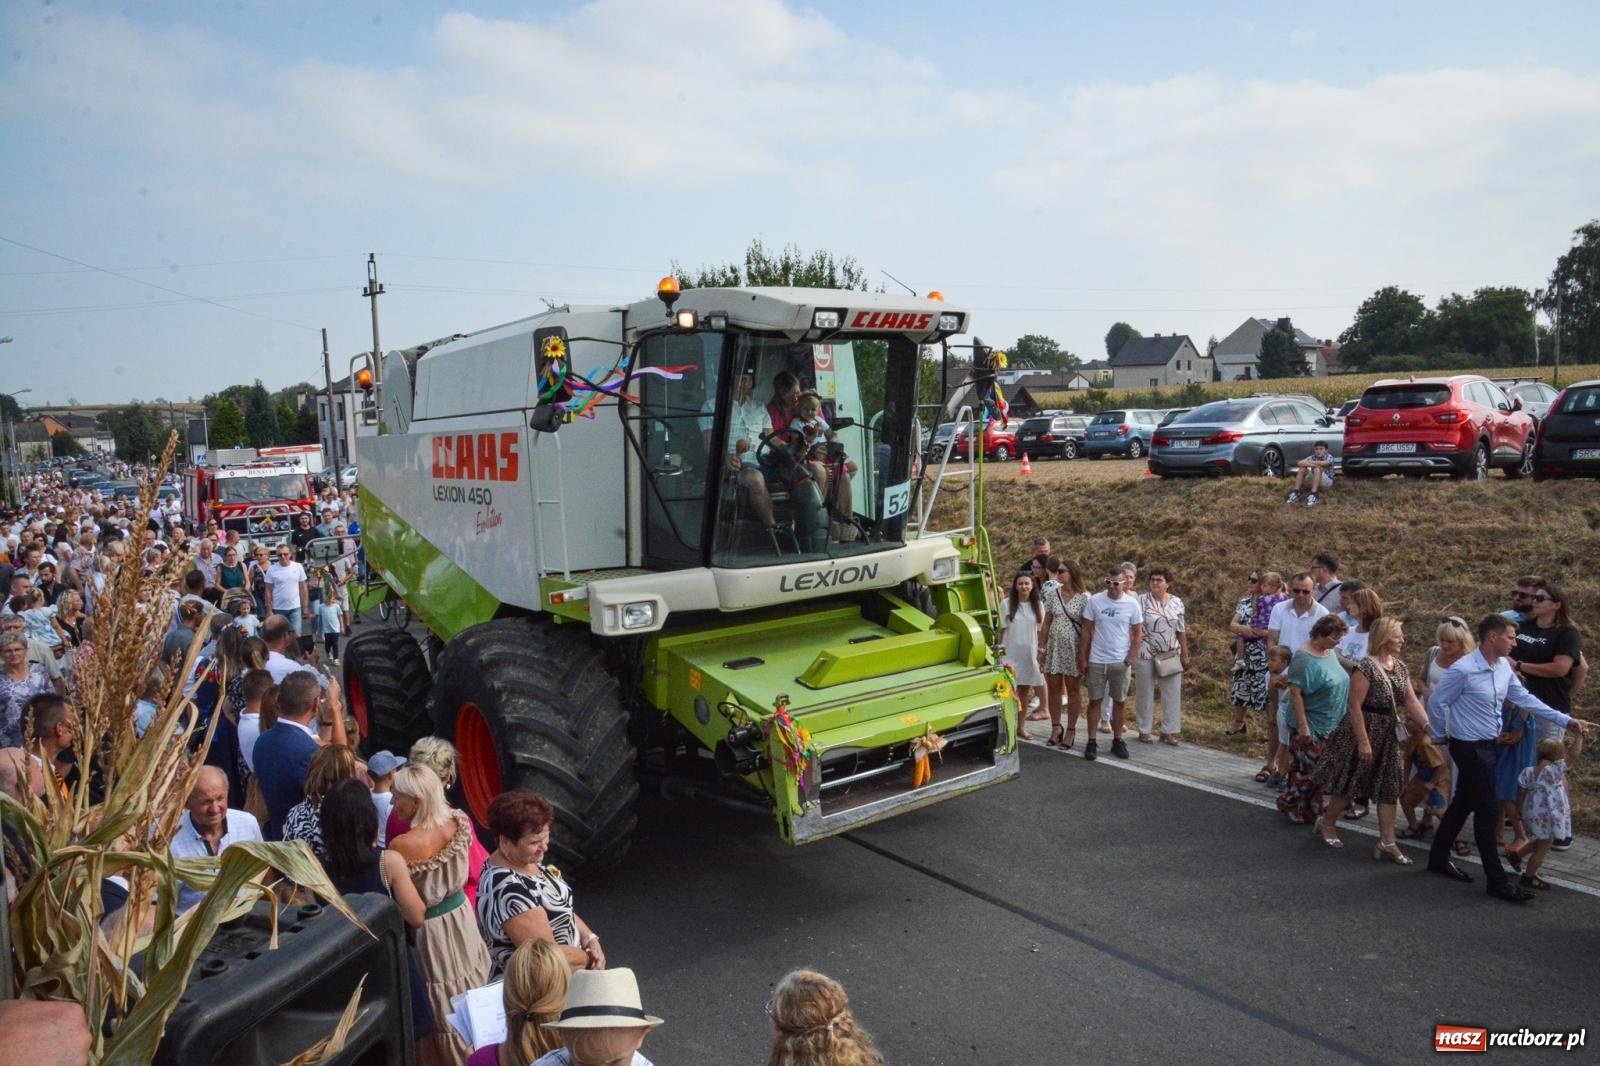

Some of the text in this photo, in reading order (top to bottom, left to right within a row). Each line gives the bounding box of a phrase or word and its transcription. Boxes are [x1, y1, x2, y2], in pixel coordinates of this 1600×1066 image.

[851, 311, 933, 330] CLAAS
[432, 432, 519, 482] CLAAS
[1579, 449, 1596, 458] SRC
[432, 484, 493, 506] LEXION 450
[888, 490, 909, 516] 52
[780, 562, 879, 593] LEXION
